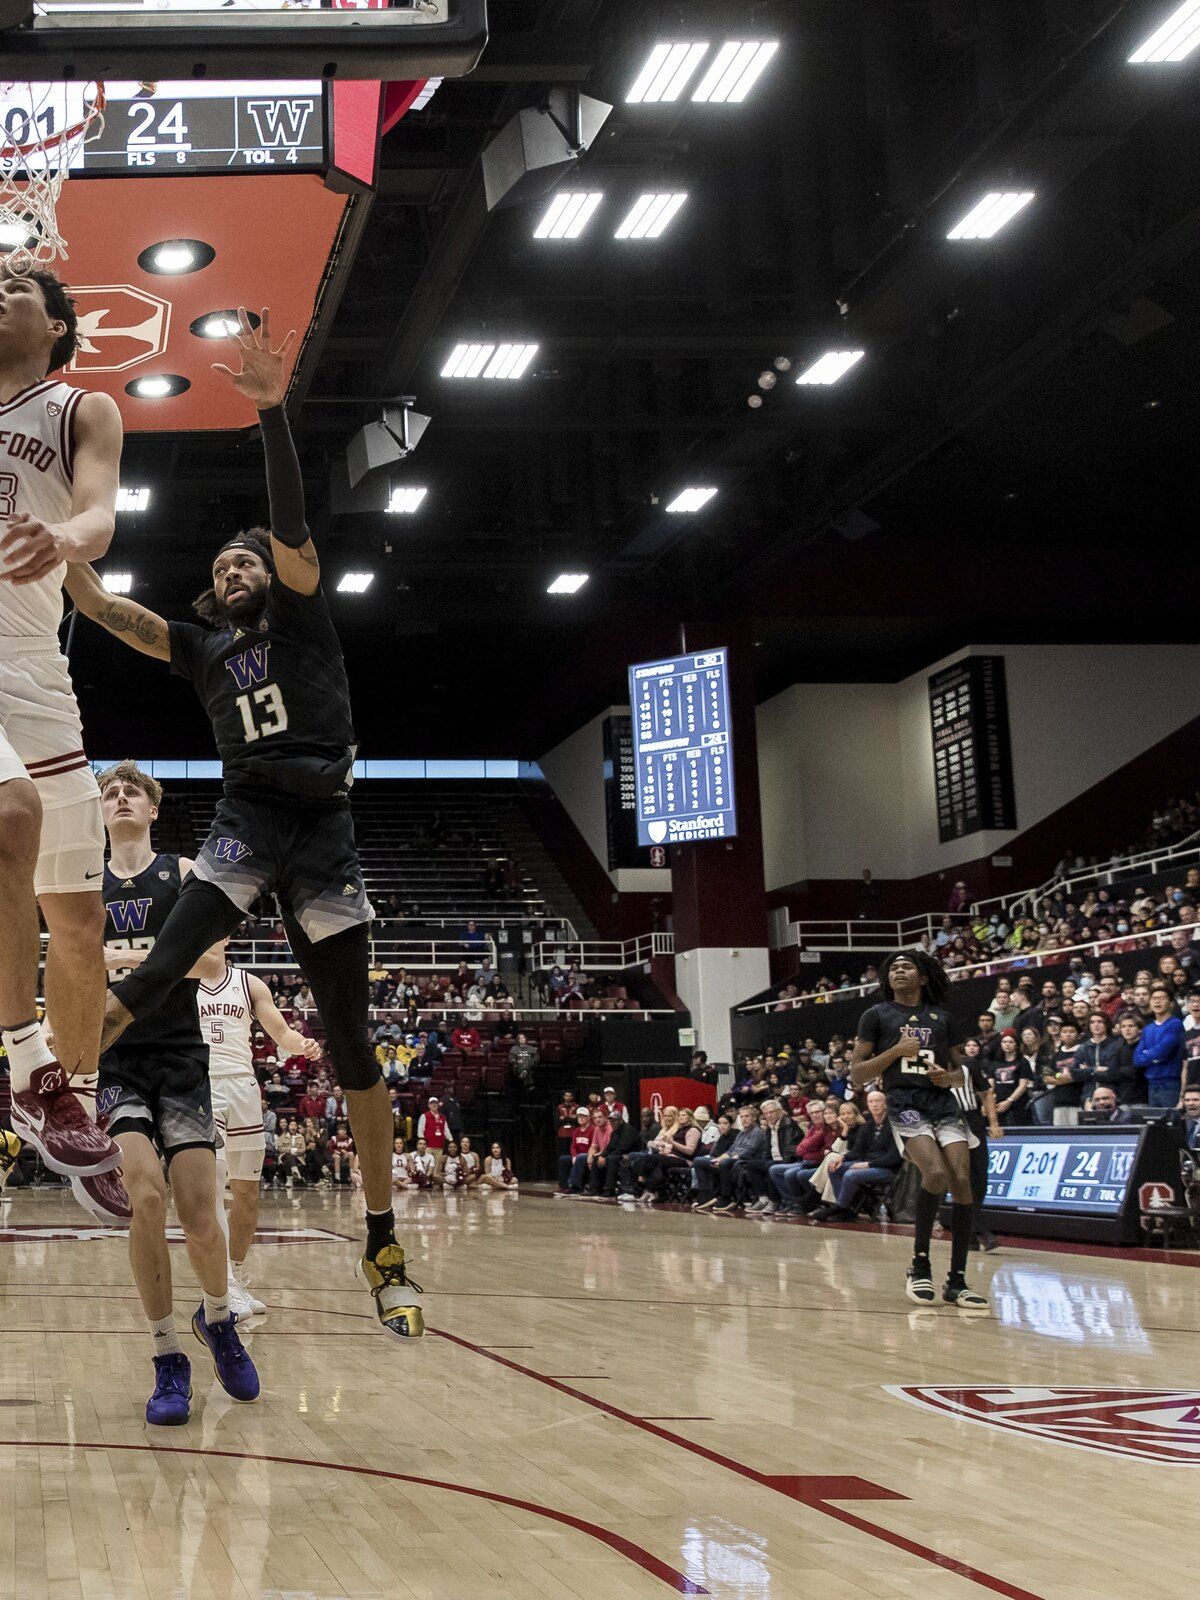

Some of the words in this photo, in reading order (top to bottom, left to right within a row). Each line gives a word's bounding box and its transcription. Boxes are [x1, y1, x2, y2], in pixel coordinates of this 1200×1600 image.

[127, 101, 189, 144] 24
[247, 100, 314, 146] W
[127, 152, 156, 166] FLS
[176, 151, 186, 164] 8
[243, 151, 275, 164] TOL
[285, 148, 298, 164] 4
[224, 640, 271, 690] W
[659, 677, 674, 688] PTS
[706, 669, 720, 680] FLS
[686, 695, 693, 704] 1
[711, 691, 718, 700] 1
[235, 683, 289, 743] 13
[687, 704, 694, 714] 2
[711, 700, 718, 709] 1
[687, 714, 694, 724] 2
[712, 710, 718, 719] 1
[688, 723, 695, 732] 3
[662, 752, 677, 762] PTS
[710, 745, 725, 755] FLS
[647, 766, 653, 775] 1
[689, 759, 697, 768] 1
[619, 774, 635, 782] 200
[665, 772, 673, 782] 7
[666, 782, 674, 791] 2
[691, 779, 698, 788] 2
[714, 775, 722, 785] 2
[620, 783, 635, 791] 200
[691, 789, 698, 798] 1
[715, 786, 723, 795] 2
[620, 792, 636, 800] 201
[621, 801, 636, 810] 201
[667, 803, 675, 812] 2
[691, 800, 699, 809] 2
[668, 813, 724, 832] Stanford
[669, 827, 725, 841] MEDICINE
[215, 836, 254, 863] W
[106, 898, 152, 932] W
[200, 1004, 245, 1019] ANFORD
[211, 1021, 224, 1044] 5
[988, 1150, 1011, 1175] 30
[1021, 1152, 1060, 1175] 2:01
[1070, 1151, 1102, 1177] 24
[1023, 1186, 1040, 1197] 1ST
[1060, 1186, 1078, 1198] FLS
[1099, 1189, 1117, 1201] TOL
